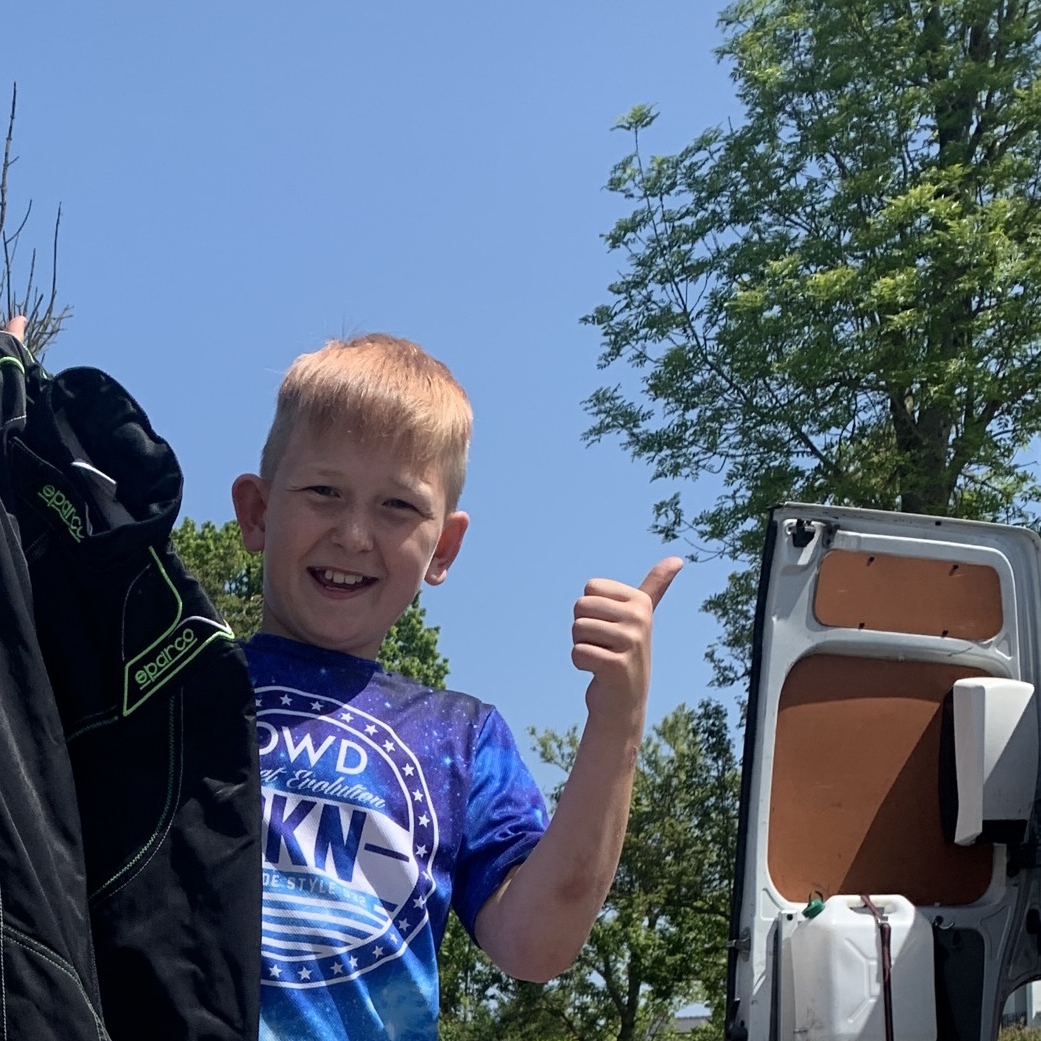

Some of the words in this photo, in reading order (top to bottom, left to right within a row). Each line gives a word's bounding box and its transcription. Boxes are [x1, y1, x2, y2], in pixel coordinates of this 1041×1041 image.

[134, 628, 197, 690] sparco
[261, 793, 367, 883] KN
[287, 876, 337, 895] STYLE
